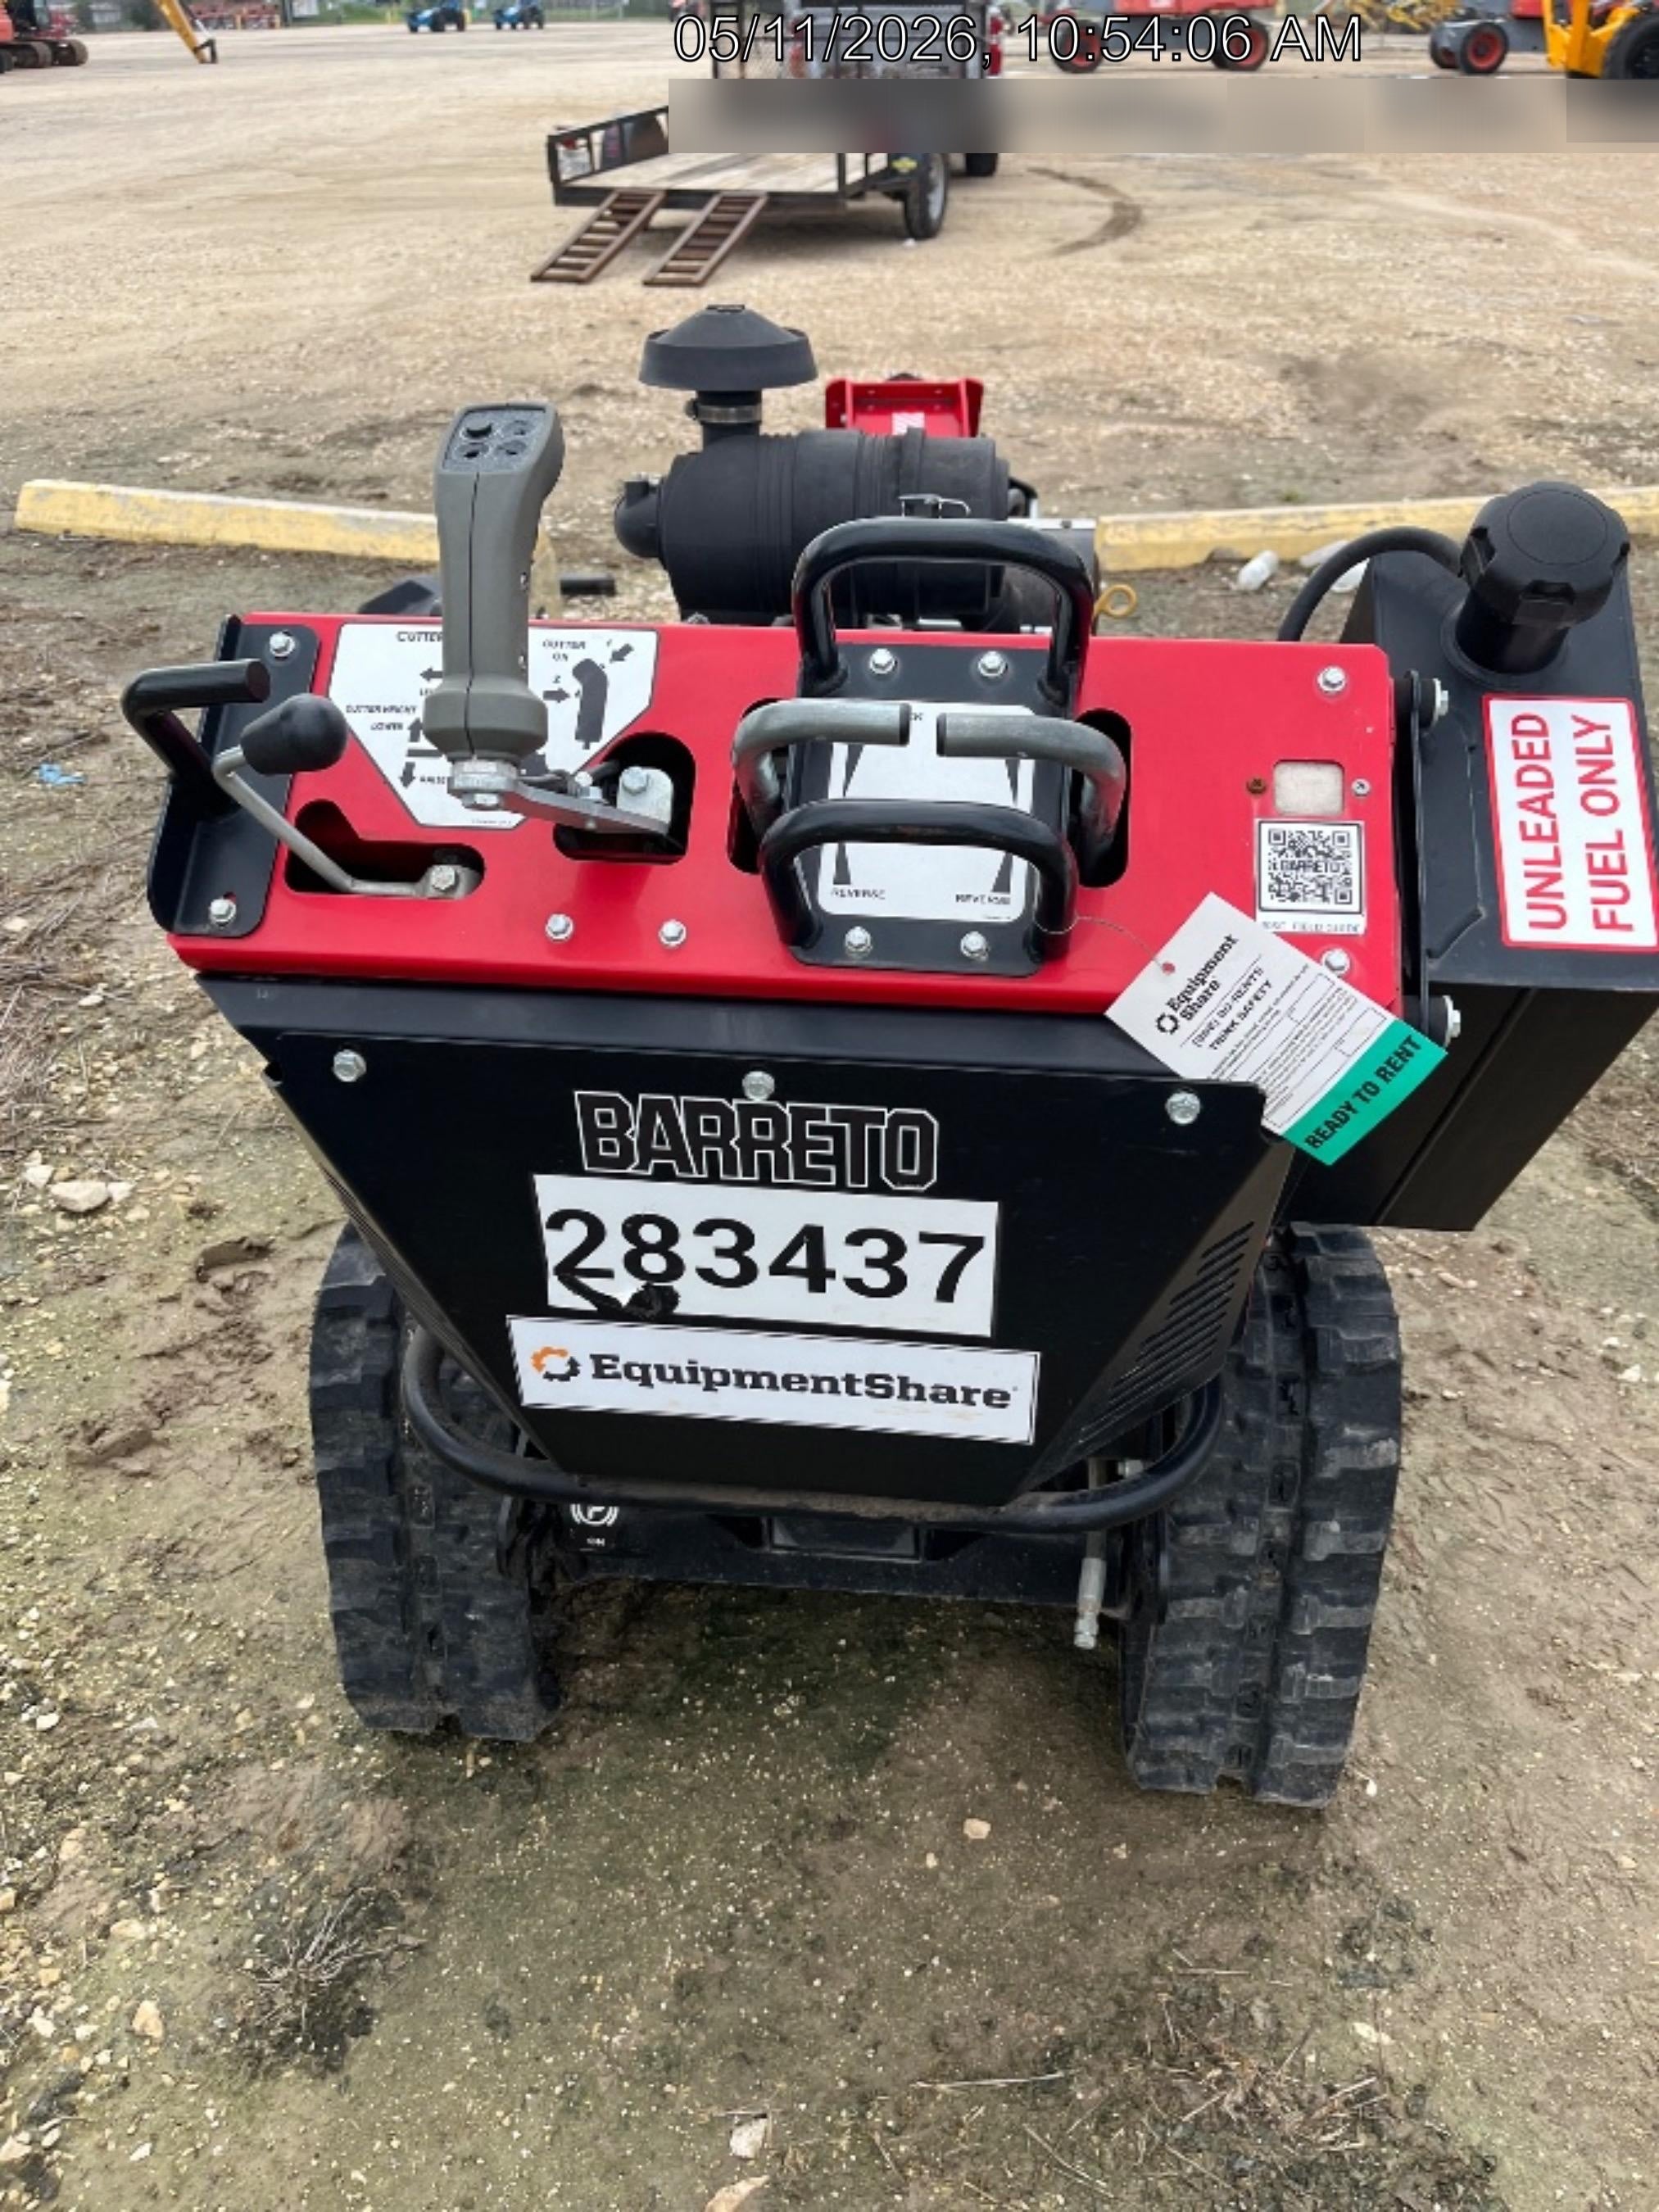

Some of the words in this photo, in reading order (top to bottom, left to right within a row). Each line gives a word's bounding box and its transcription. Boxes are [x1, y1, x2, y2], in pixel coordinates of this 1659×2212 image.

[1571, 714, 1620, 817] ONLY
[1512, 714, 1567, 929] UNLEADED
[1585, 829, 1634, 931] FUEL
[1166, 934, 1238, 1012] Equipment
[1180, 980, 1220, 1020] Share
[1209, 1019, 1239, 1049] THINK
[1236, 980, 1272, 1020] SAFETY
[575, 1090, 939, 1190] BARRETO
[1304, 1101, 1359, 1149] READY
[1353, 1081, 1380, 1104] TO
[1375, 1035, 1422, 1084] RENT
[545, 1208, 986, 1303] 283437
[589, 1353, 1013, 1410] EquipmentShare
